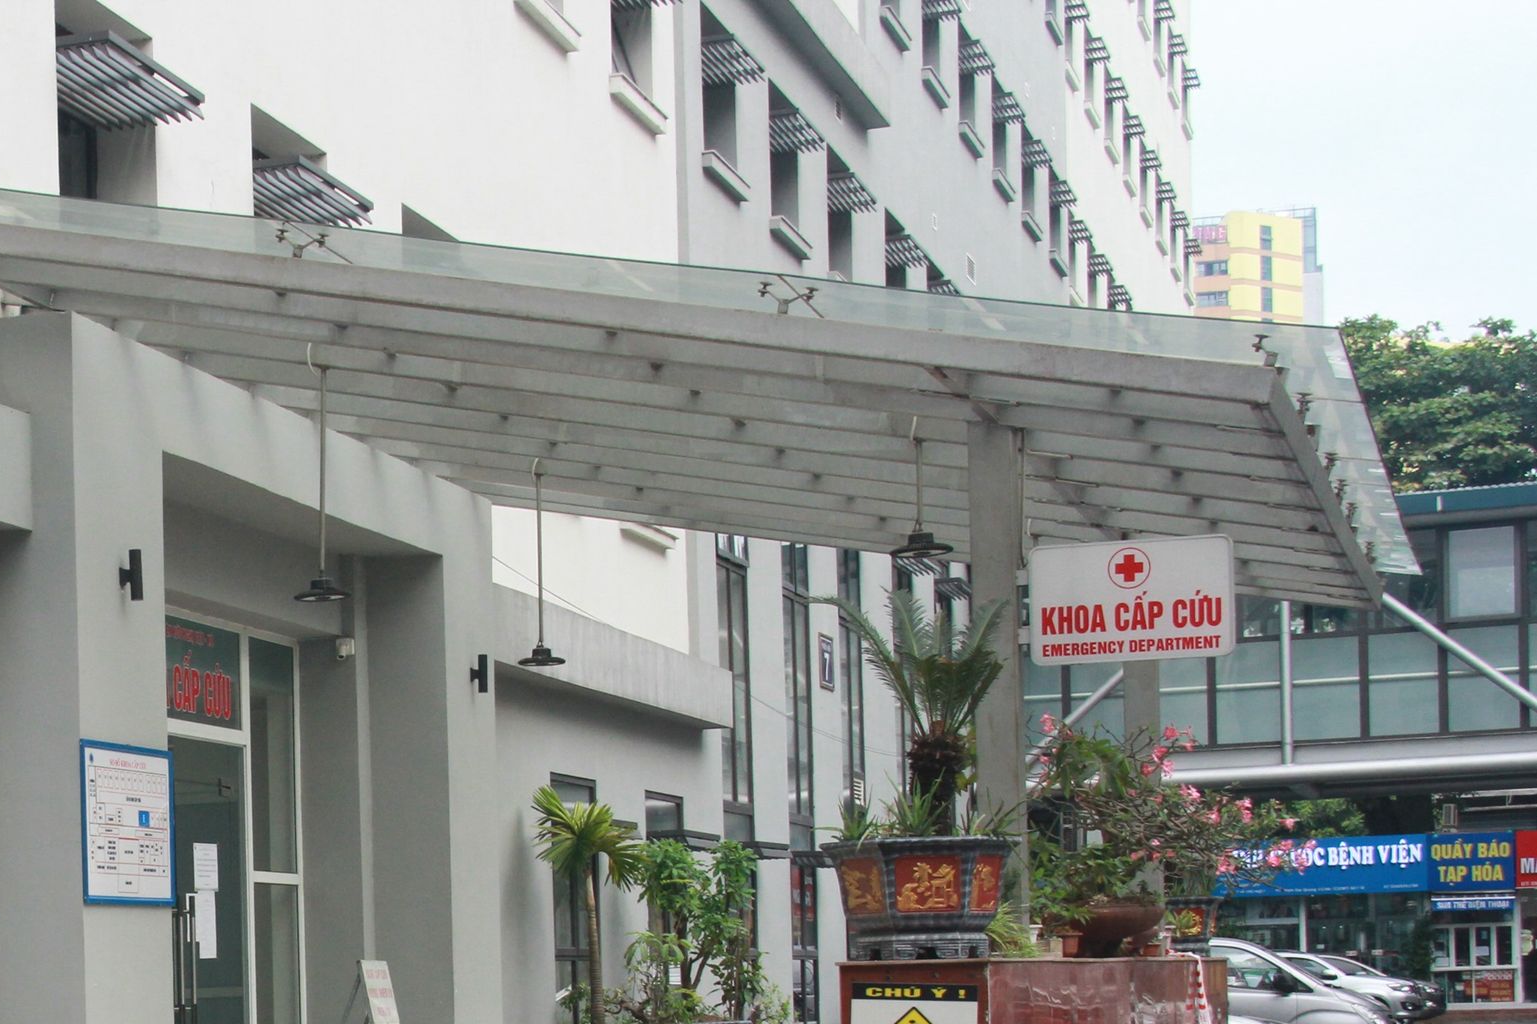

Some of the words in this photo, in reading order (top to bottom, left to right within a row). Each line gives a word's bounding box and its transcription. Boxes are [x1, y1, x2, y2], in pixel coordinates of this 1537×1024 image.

[1041, 603, 1107, 636] KHOA
[1114, 591, 1164, 632] CẤP
[1172, 589, 1222, 629] CỨU
[1042, 639, 1125, 658] EMERGENCY
[1129, 635, 1222, 653] DEPARTMENT
[1328, 841, 1375, 871] BỆNH
[1377, 838, 1424, 869] VIỆN
[1477, 838, 1511, 859] BÁO
[1437, 865, 1469, 887] TẠP
[1471, 861, 1505, 882] HÓA
[865, 985, 922, 999] CHÚ
[931, 986, 947, 999] Ý
